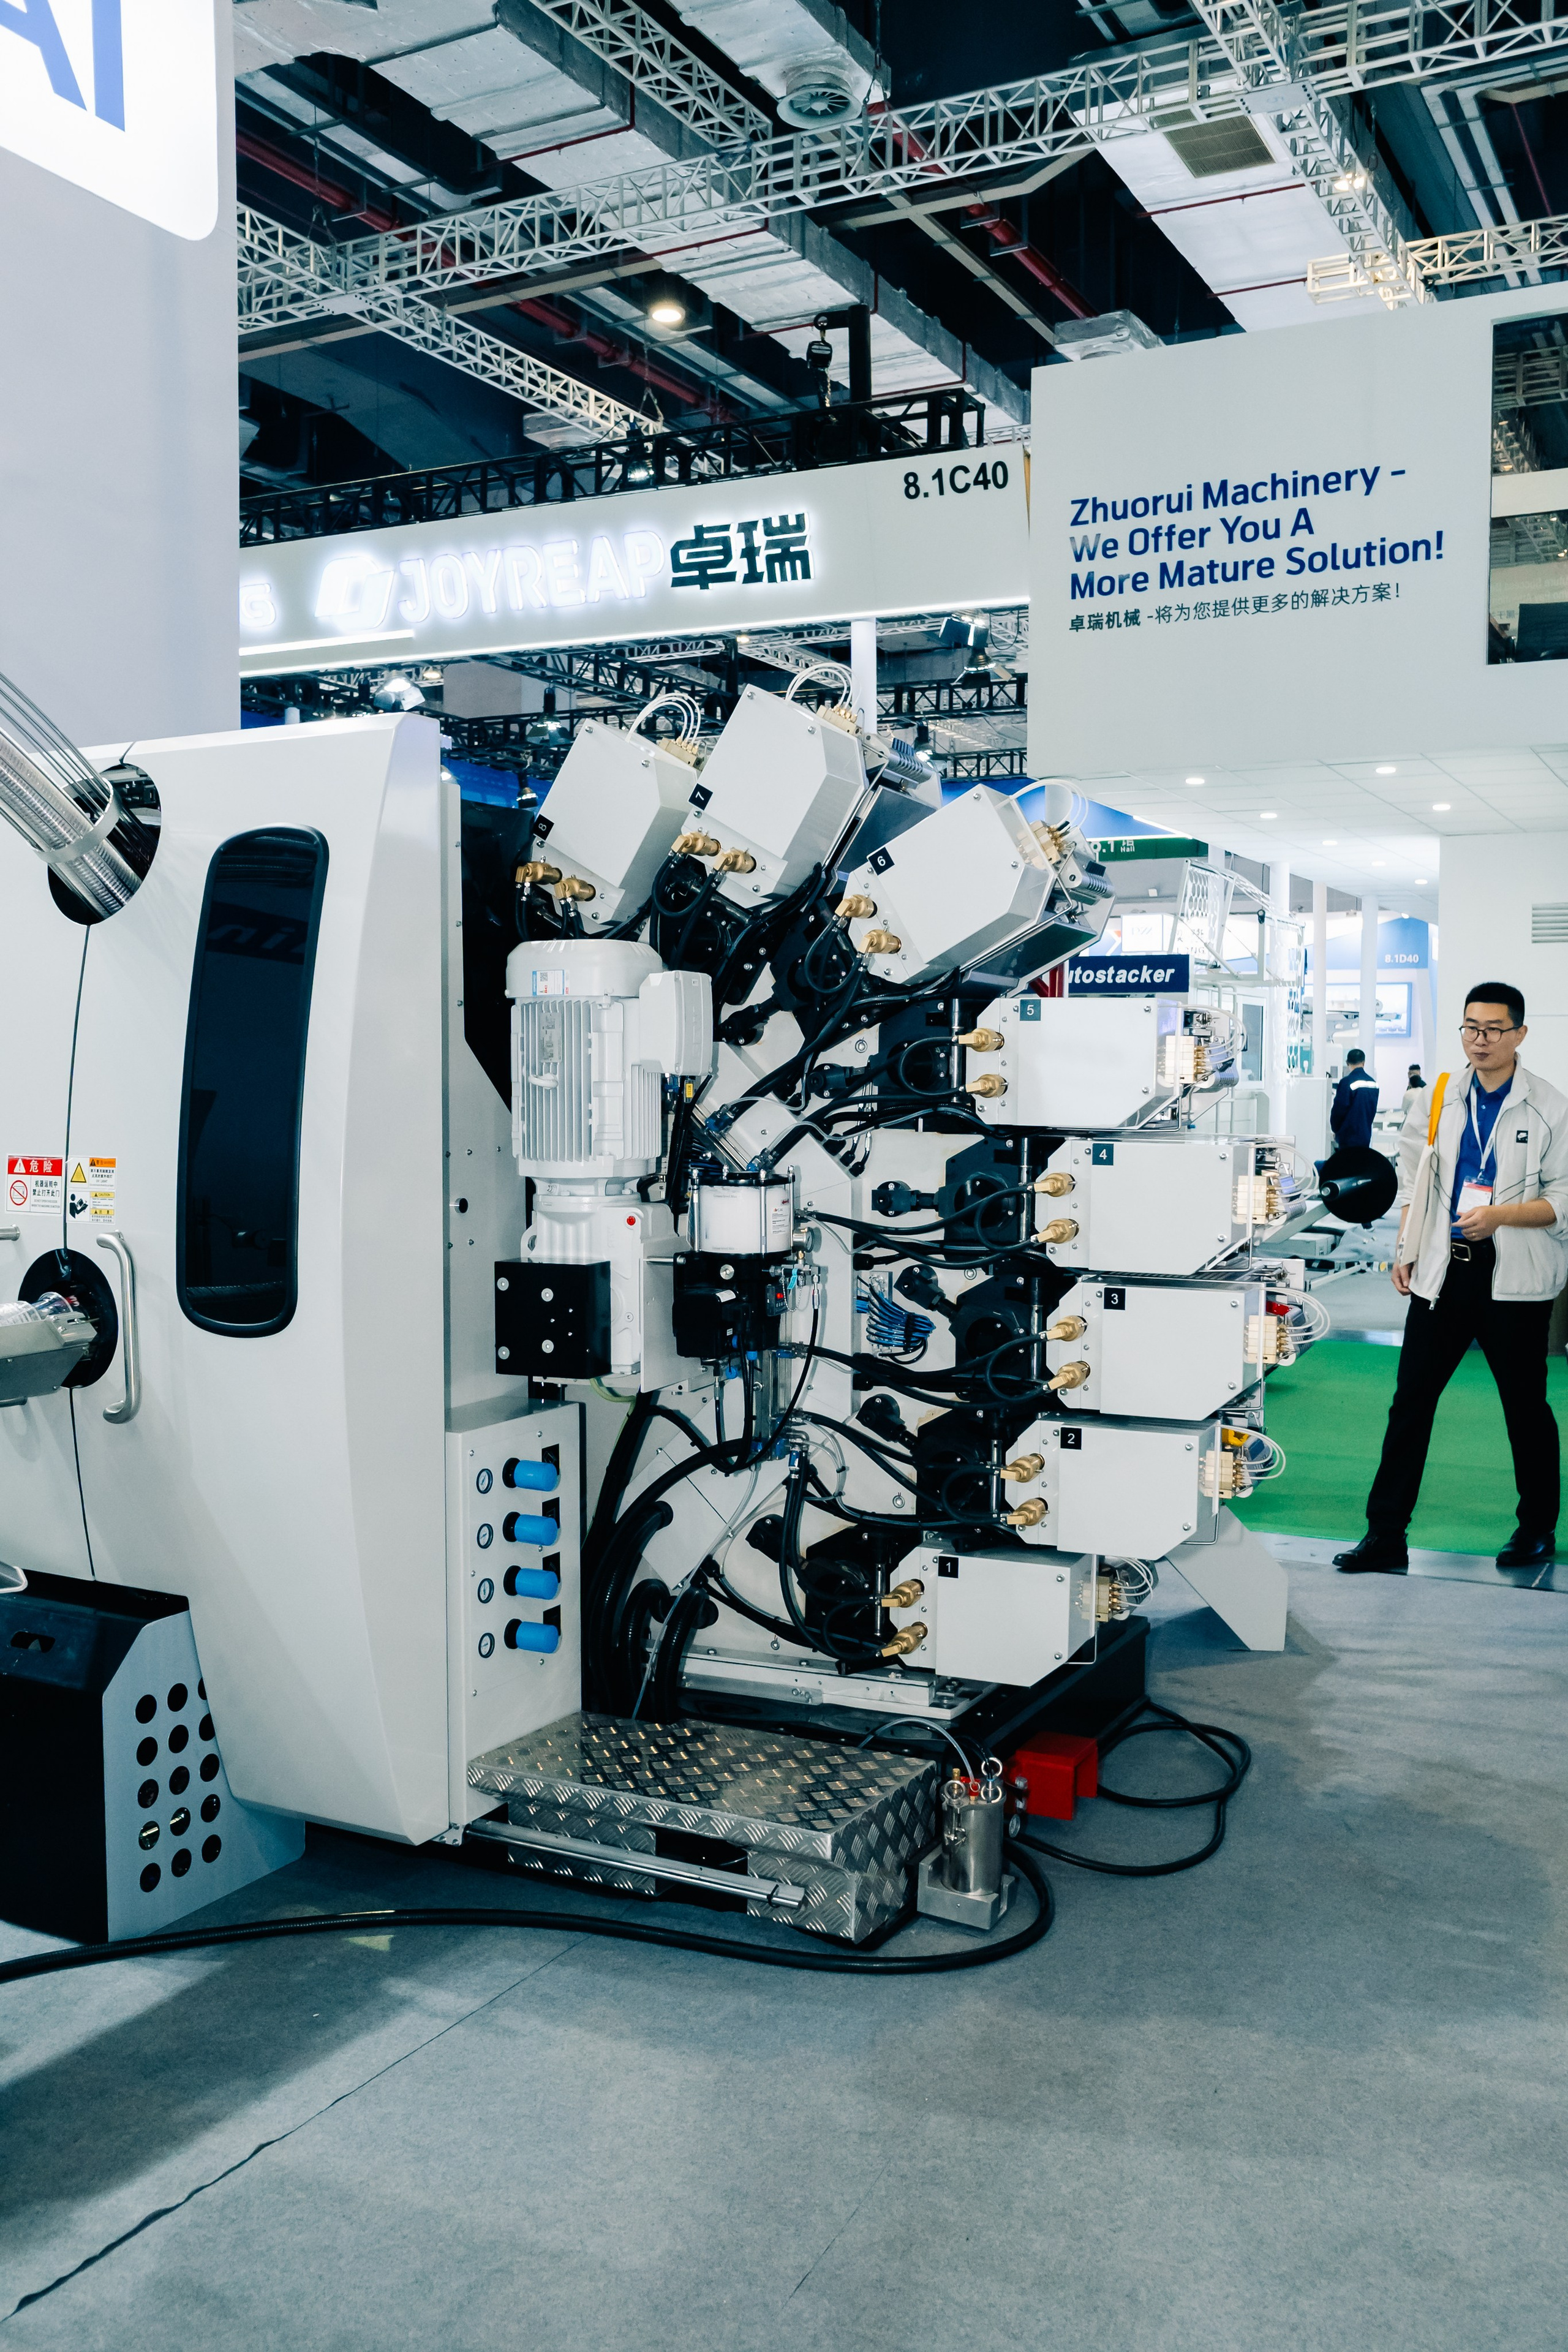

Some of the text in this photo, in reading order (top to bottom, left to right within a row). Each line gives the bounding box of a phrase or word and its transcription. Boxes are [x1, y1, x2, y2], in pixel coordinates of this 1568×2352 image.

[903, 460, 1009, 500] 8.1C40
[1070, 483, 1193, 527] Zhuorui
[1203, 466, 1381, 510] Machinery
[1069, 507, 1315, 563] We Offer You A
[397, 512, 813, 624] JOYREAP 卓瑞
[1070, 530, 1444, 600] More Mature Solution!
[1069, 608, 1141, 633] 卓瑞机械
[695, 791, 704, 801] 7
[877, 856, 886, 867] 6
[1385, 954, 1419, 963] 8.1D40
[1027, 1005, 1035, 1016] 5
[1099, 1148, 1107, 1160] 4
[29, 1159, 53, 1173] 危险
[1111, 1293, 1118, 1305] 3
[1067, 1433, 1075, 1444] 2
[946, 1562, 951, 1573] 1
